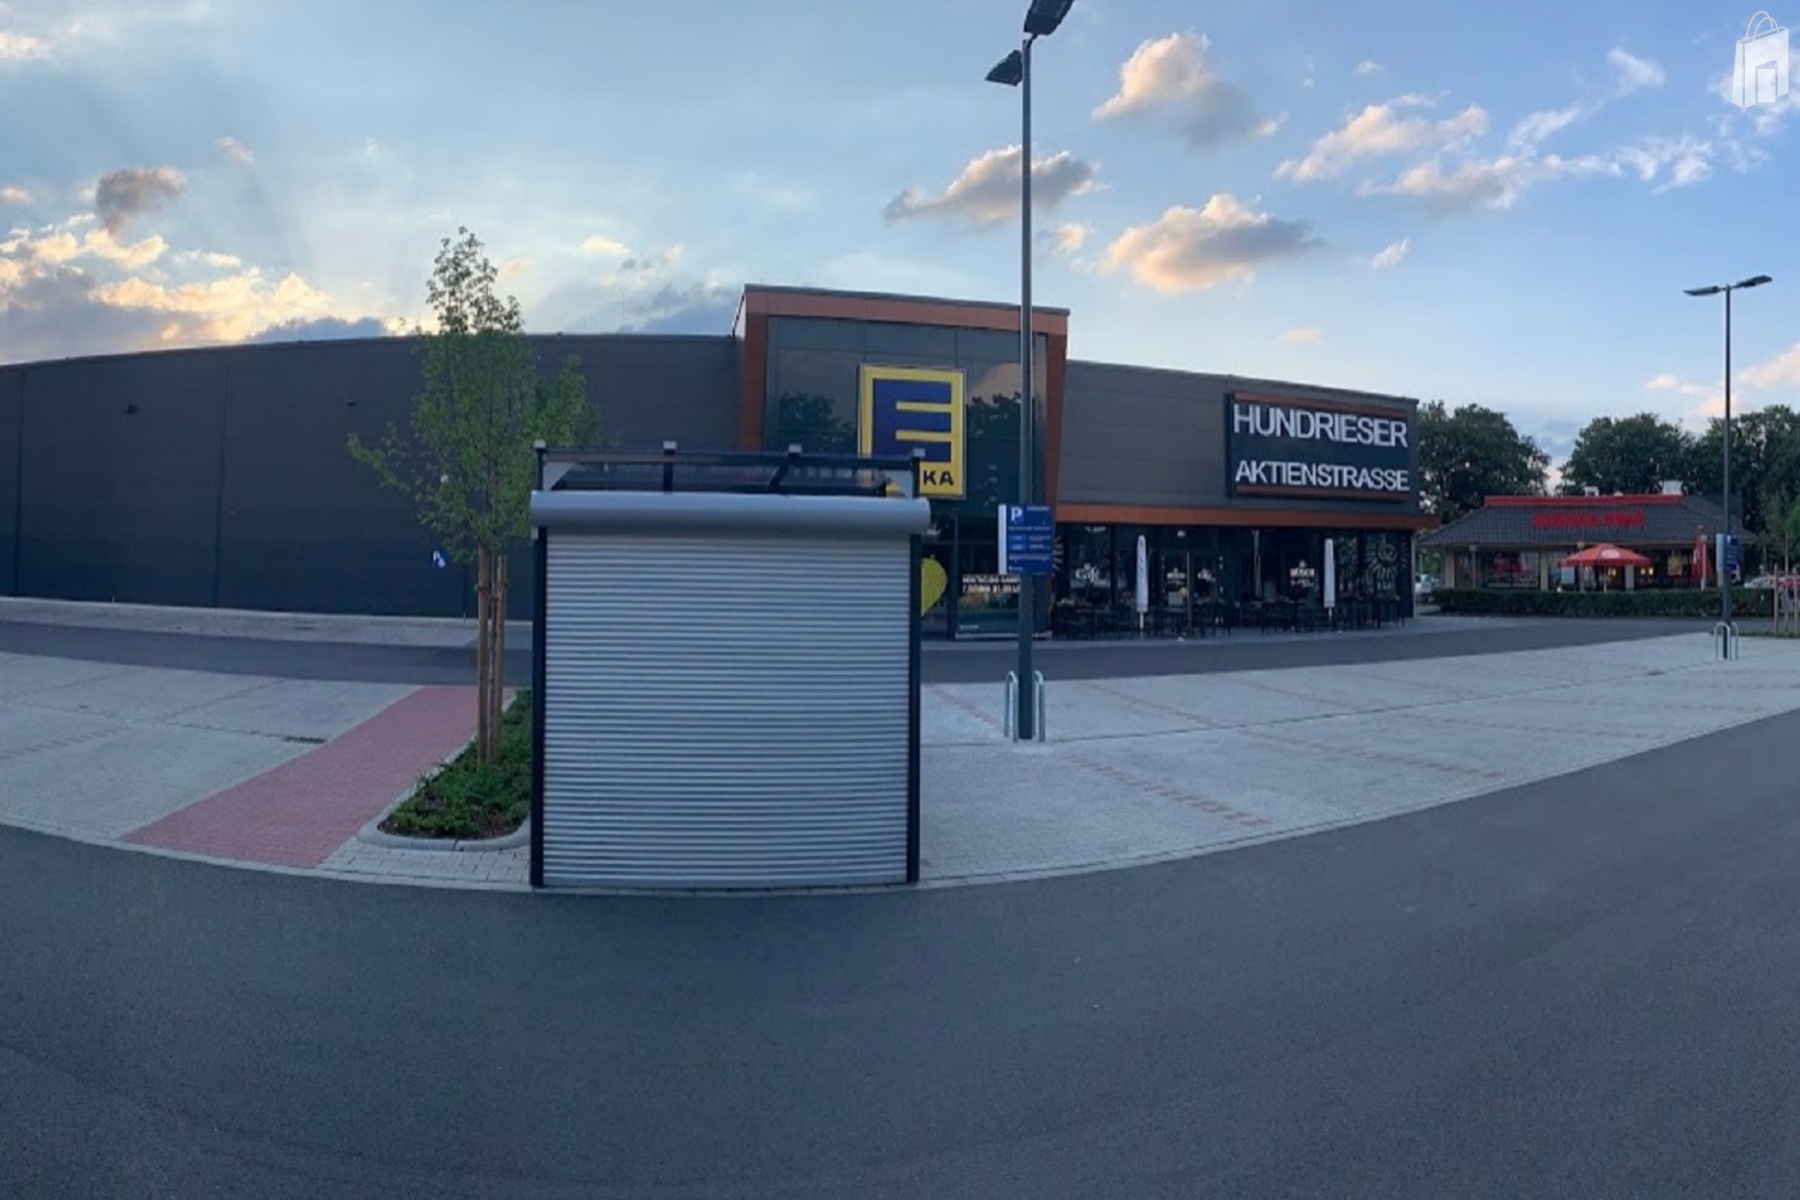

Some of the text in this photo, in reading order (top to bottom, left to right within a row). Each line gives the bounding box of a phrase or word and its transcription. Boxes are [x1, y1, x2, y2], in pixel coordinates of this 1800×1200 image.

[1234, 403, 1408, 448] HUNDRIESER
[1235, 459, 1410, 491] AKTIENSTRASSE
[1011, 507, 1023, 521] P
